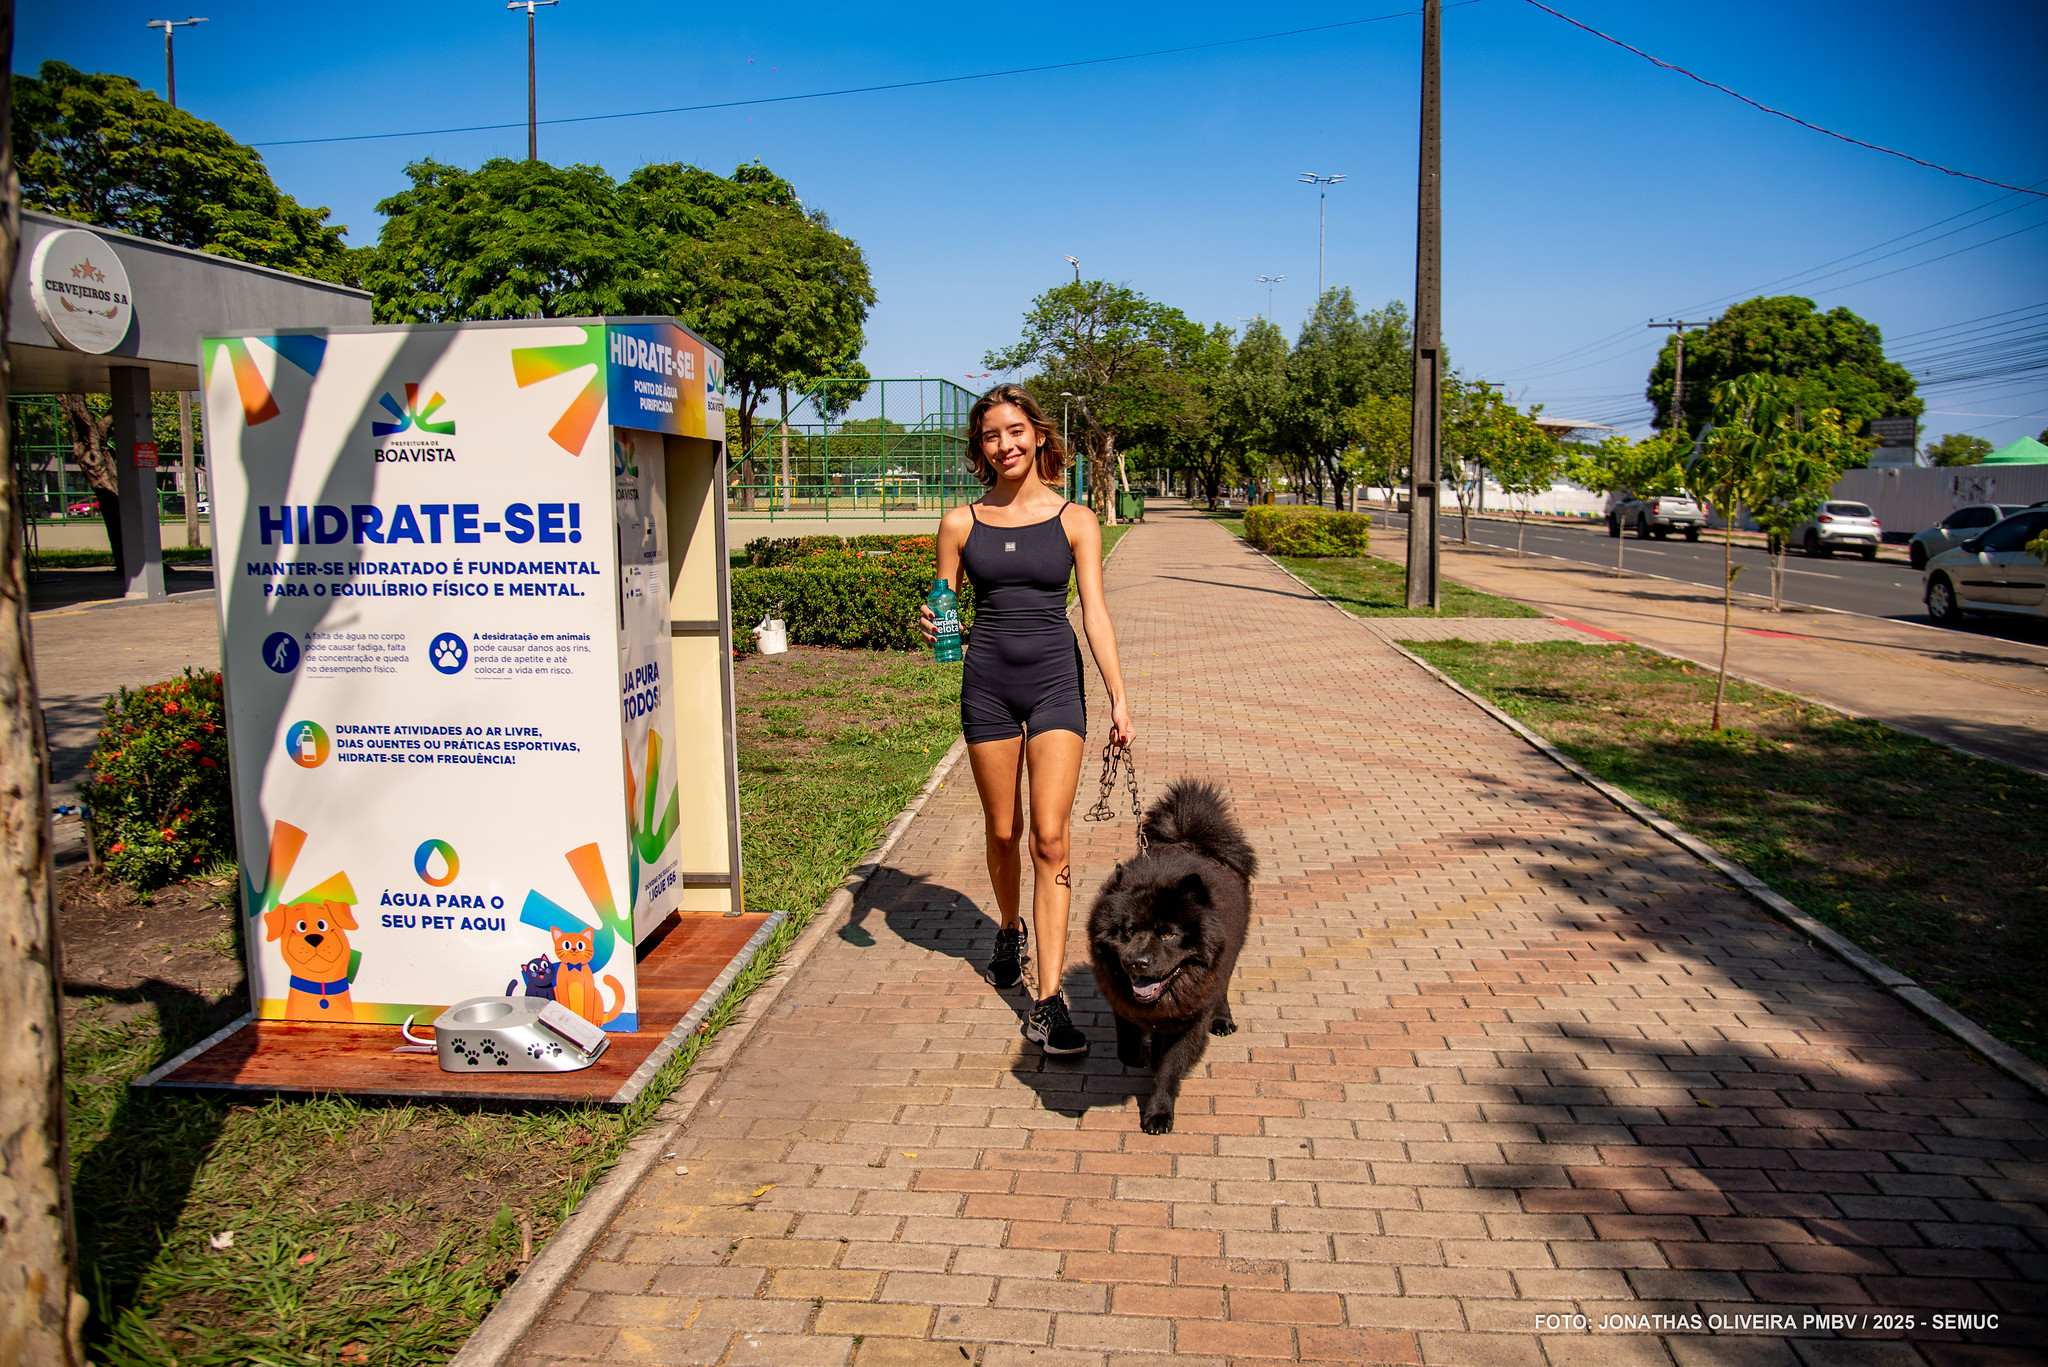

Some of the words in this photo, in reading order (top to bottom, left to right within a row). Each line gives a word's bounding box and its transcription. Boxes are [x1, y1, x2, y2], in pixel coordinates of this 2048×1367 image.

[45, 280, 111, 301] CERVEJEIROS
[114, 293, 128, 305] S.A
[610, 331, 694, 380] HIDRATE-SE!
[634, 380, 655, 396] PONTO
[655, 385, 662, 396] DE
[663, 383, 678, 399] ÁGUA
[640, 397, 673, 414] PURIFICADA
[258, 503, 582, 545] HIDRATE-SE!
[248, 562, 344, 576] MANTER-SE
[349, 562, 448, 575] HIDRATADO
[454, 558, 463, 575] É
[468, 562, 600, 575] FUNDAMENTAL
[263, 583, 309, 597] PARA
[313, 583, 326, 597] O
[332, 579, 427, 597] EQUILÍBRIO
[433, 580, 488, 597] FÍSICO
[494, 583, 503, 596] E
[509, 583, 585, 597] MENTAL.
[938, 624, 958, 633] elota
[305, 632, 311, 640] A
[313, 632, 331, 640] falta
[334, 632, 344, 640] de
[346, 632, 366, 642] água
[381, 633, 405, 642] corpo
[482, 633, 538, 642] desidratação
[305, 643, 326, 653] pode
[357, 643, 385, 653] fadiga,
[388, 643, 405, 651] falta
[473, 644, 495, 653] pode
[573, 644, 591, 653] rins,
[306, 654, 316, 662] de
[318, 654, 373, 663] concentração
[383, 654, 409, 664] queda
[474, 655, 498, 664] perda
[501, 655, 512, 663] de
[514, 655, 544, 664] apetite
[319, 665, 371, 674] desempenho
[374, 665, 397, 673] físico.
[474, 666, 505, 674] colocar
[515, 666, 533, 674] vida
[636, 661, 659, 689] PURA
[624, 684, 661, 723] TODOS!
[336, 725, 391, 735] DURANTE
[394, 725, 462, 736] ATIVIDADES
[465, 726, 483, 736] AO
[485, 726, 502, 736] AR
[505, 727, 542, 738] LIVRE,
[337, 739, 364, 749] DIAS
[367, 739, 421, 749] QUENTES
[424, 740, 441, 749] OU
[444, 738, 501, 750] PRÁTICAS
[504, 741, 580, 753] ESPORTIVAS,
[338, 753, 405, 763] HIDRATE-SE
[408, 754, 434, 763] COM
[437, 753, 515, 765] FREQUÊNCIA!
[649, 879, 666, 903] LIGUE
[667, 870, 676, 887] 156
[380, 889, 431, 907] ÁGUA
[436, 894, 485, 909] PARA
[490, 896, 505, 910] O
[381, 914, 415, 929] SEU
[421, 916, 455, 930] PET
[460, 917, 506, 932] AQUI
